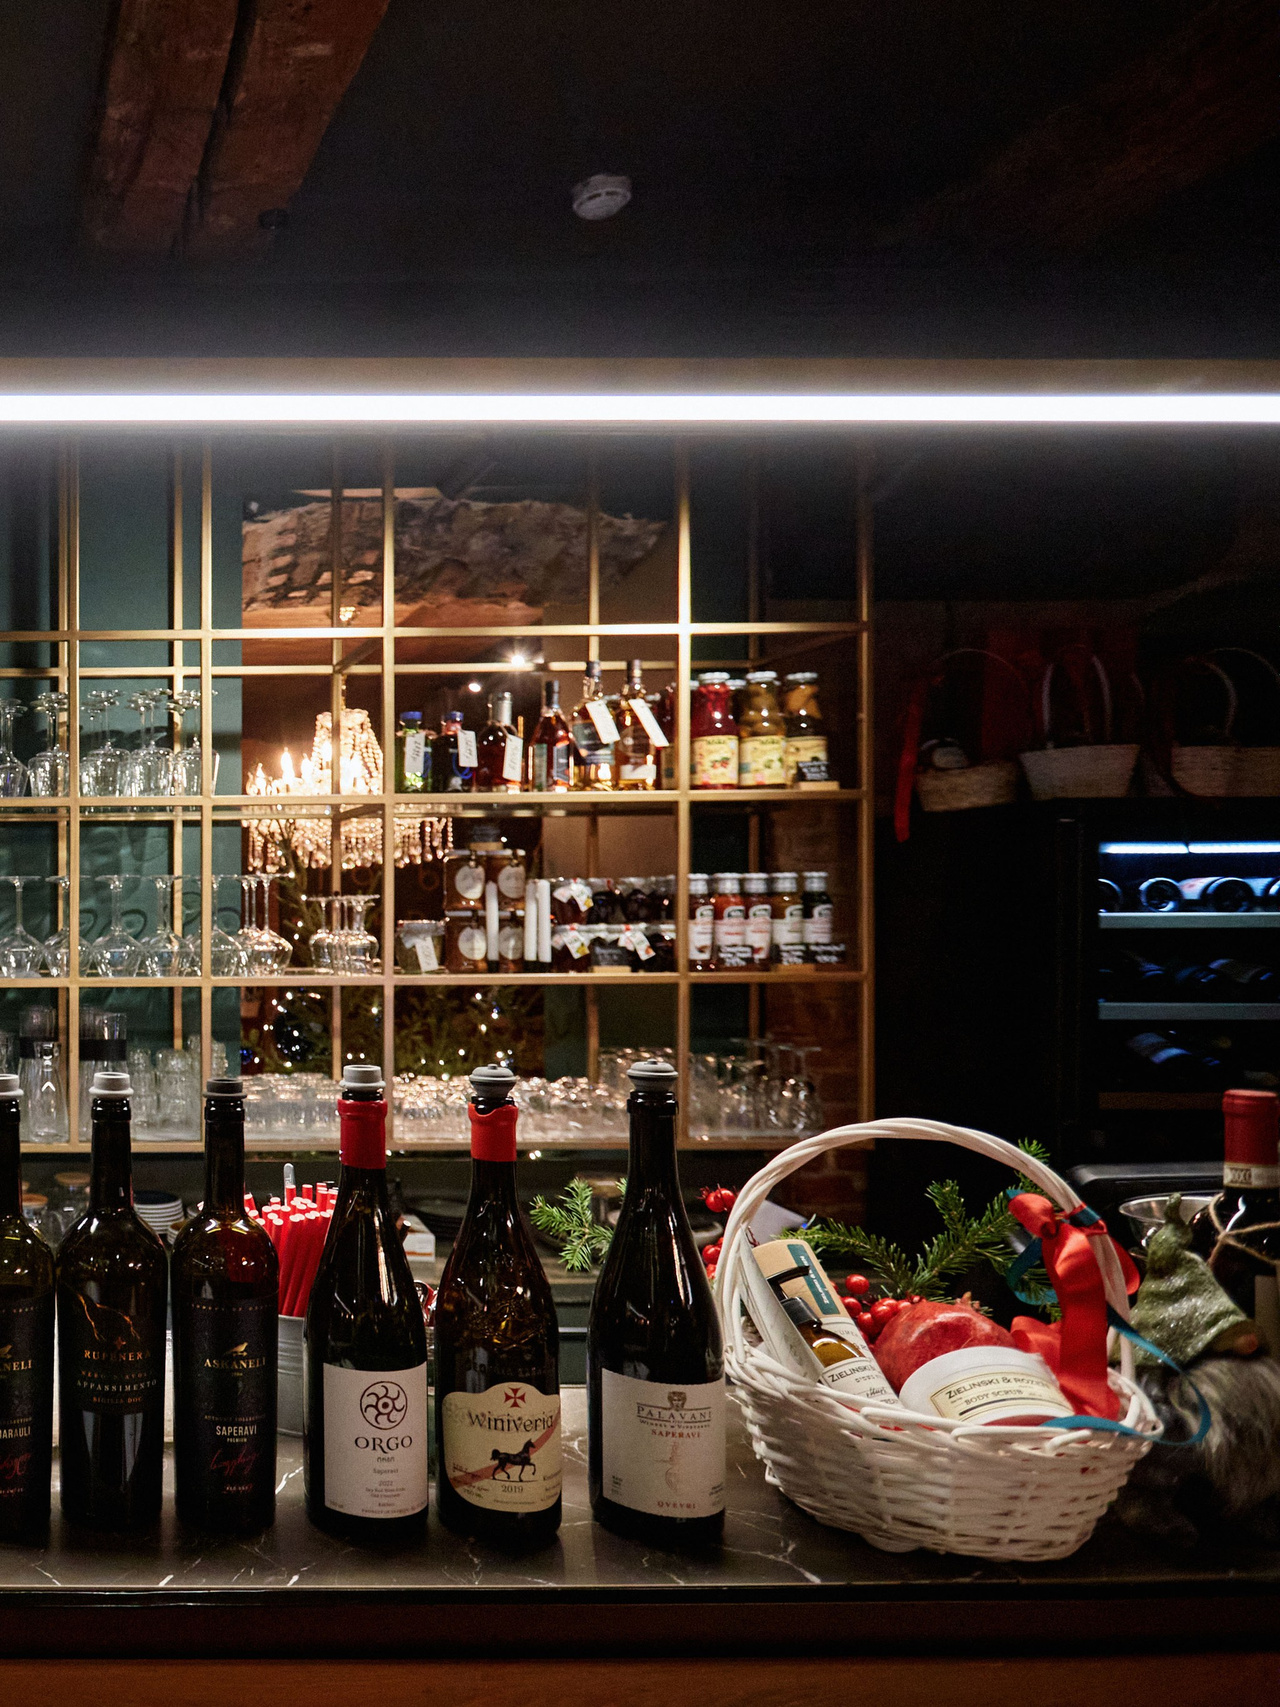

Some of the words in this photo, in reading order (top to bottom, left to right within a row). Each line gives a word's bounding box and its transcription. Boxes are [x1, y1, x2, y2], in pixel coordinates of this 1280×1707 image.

[204, 1357, 266, 1369] ASKANELI
[828, 1363, 869, 1383] ZIELINSKI
[945, 1378, 1000, 1400] ZIELINSKI
[1001, 1376, 1011, 1384] &
[964, 1393, 990, 1406] BODY
[636, 1405, 712, 1420] PALAVANI
[215, 1425, 257, 1436] SAPERAVI
[651, 1428, 701, 1438] SAPERAVI
[354, 1435, 413, 1454] ORGO
[501, 1484, 524, 1494] 2019
